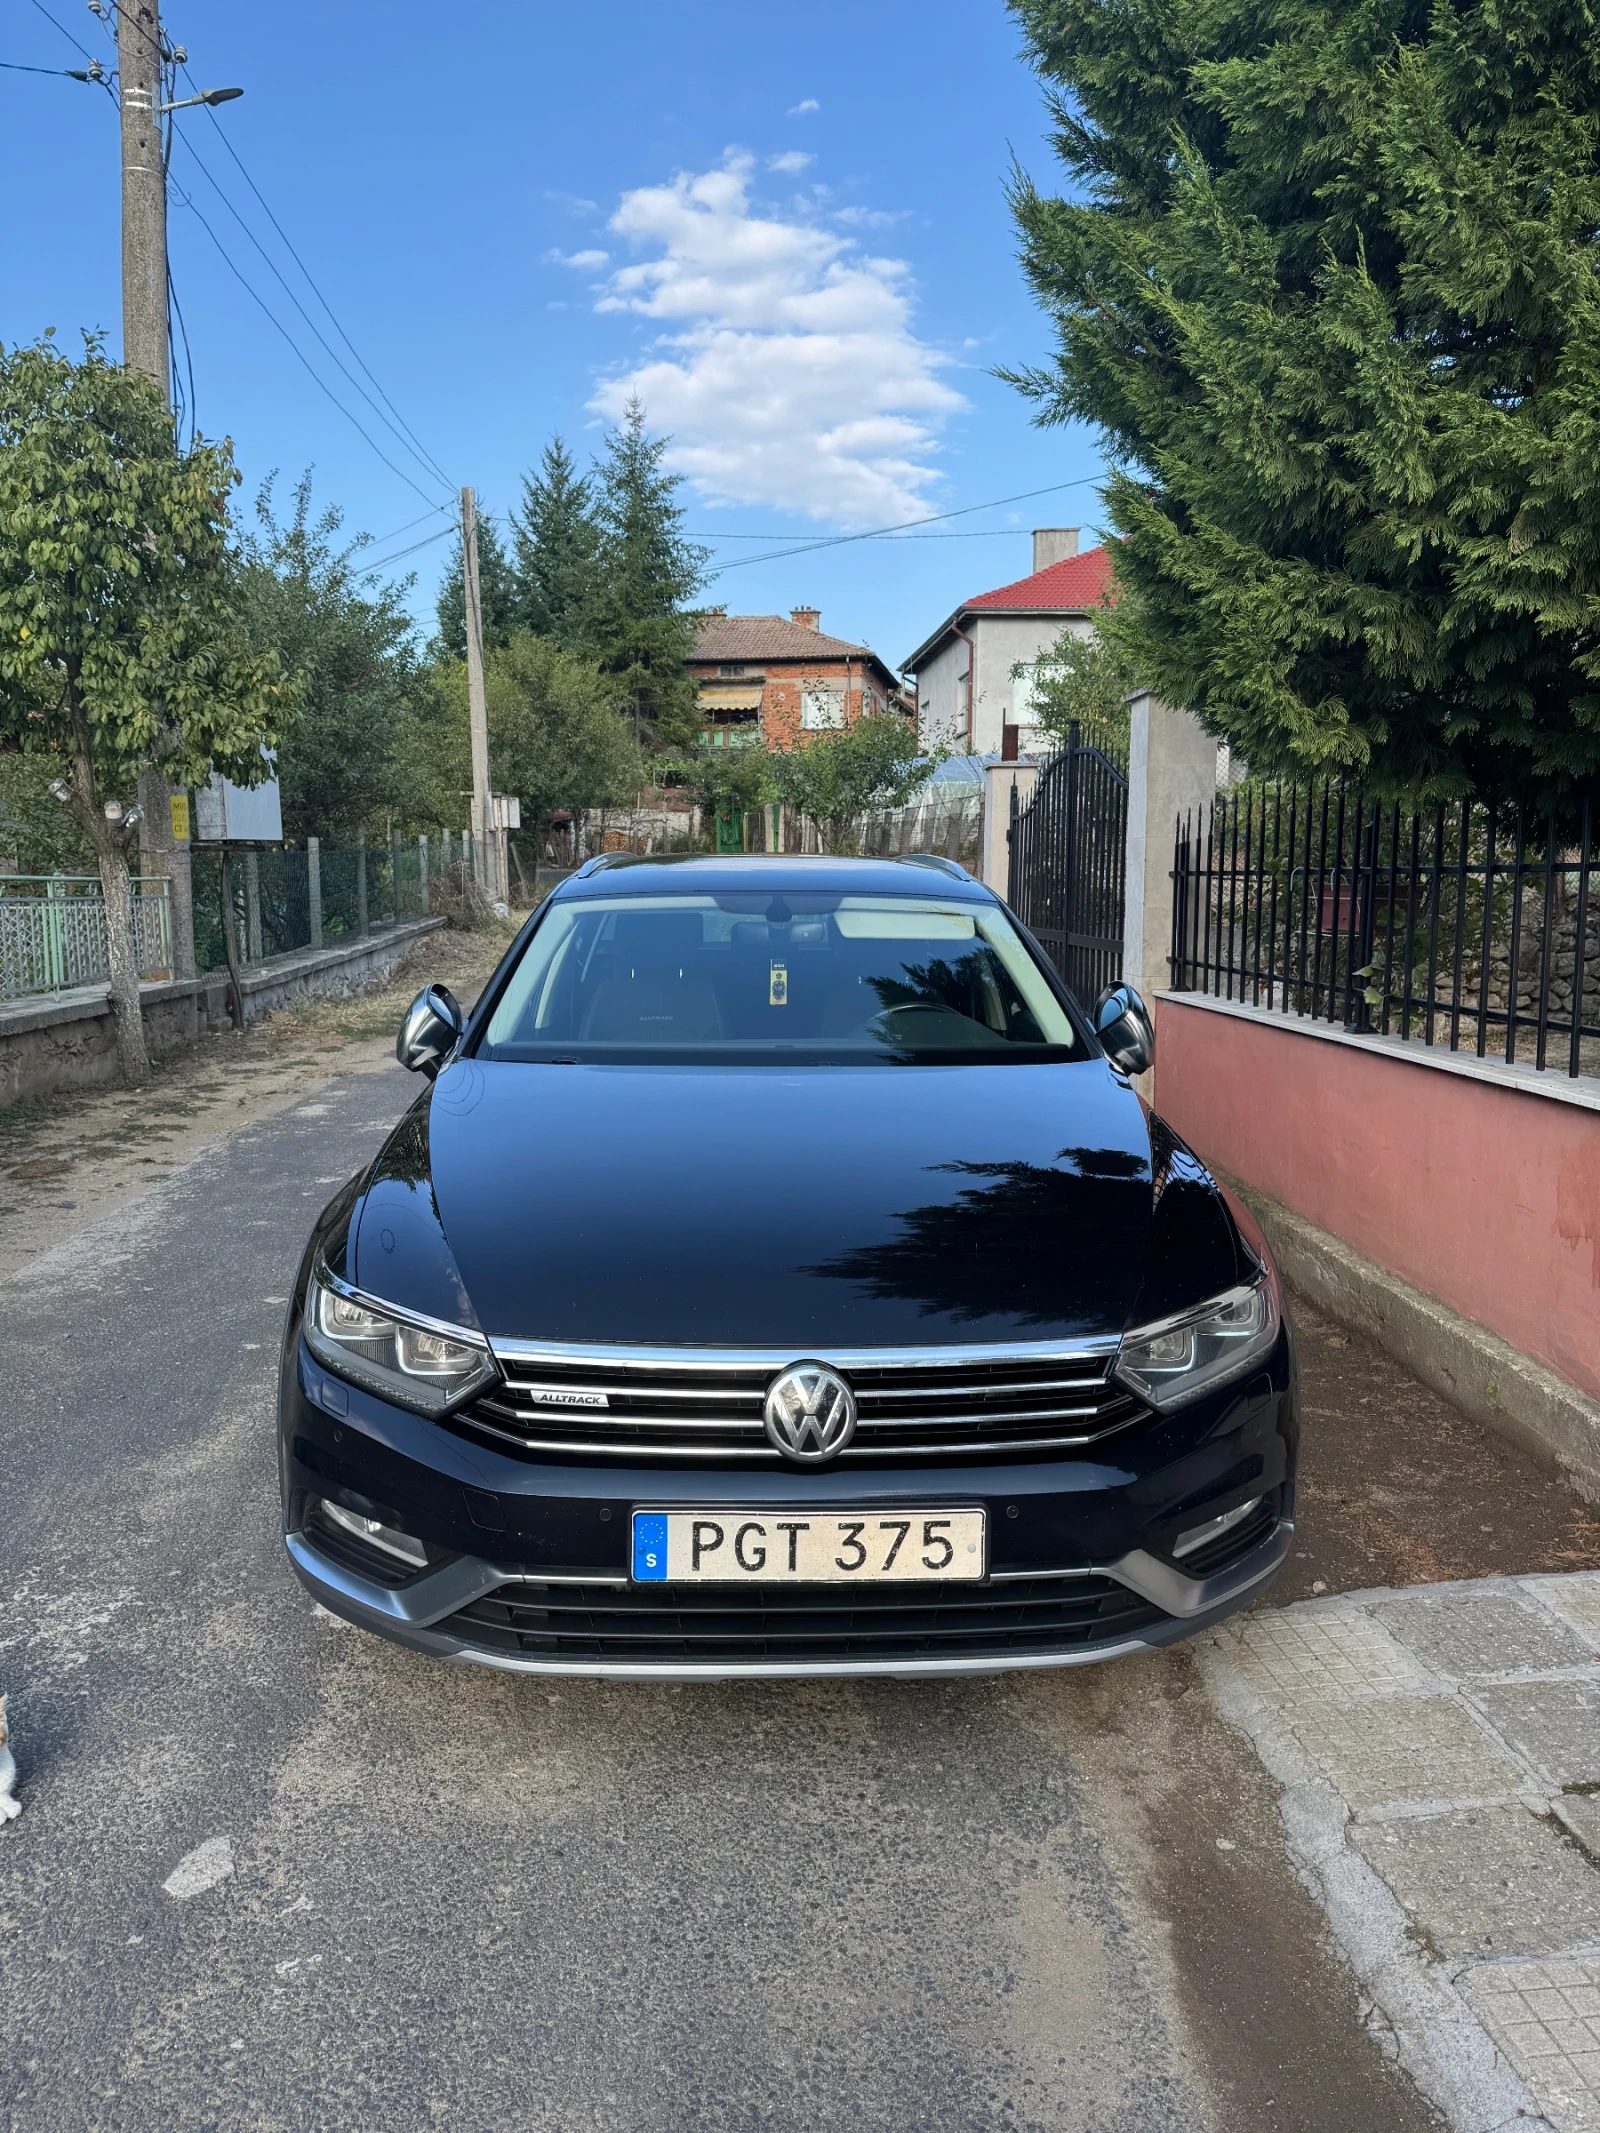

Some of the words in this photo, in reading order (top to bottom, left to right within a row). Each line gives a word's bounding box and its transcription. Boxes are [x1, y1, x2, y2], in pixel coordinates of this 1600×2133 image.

[539, 1394, 601, 1404] ALLTRACK
[774, 1371, 846, 1456] VW
[645, 1553, 657, 1568] S
[691, 1521, 810, 1572] PGT
[834, 1520, 954, 1571] 375
